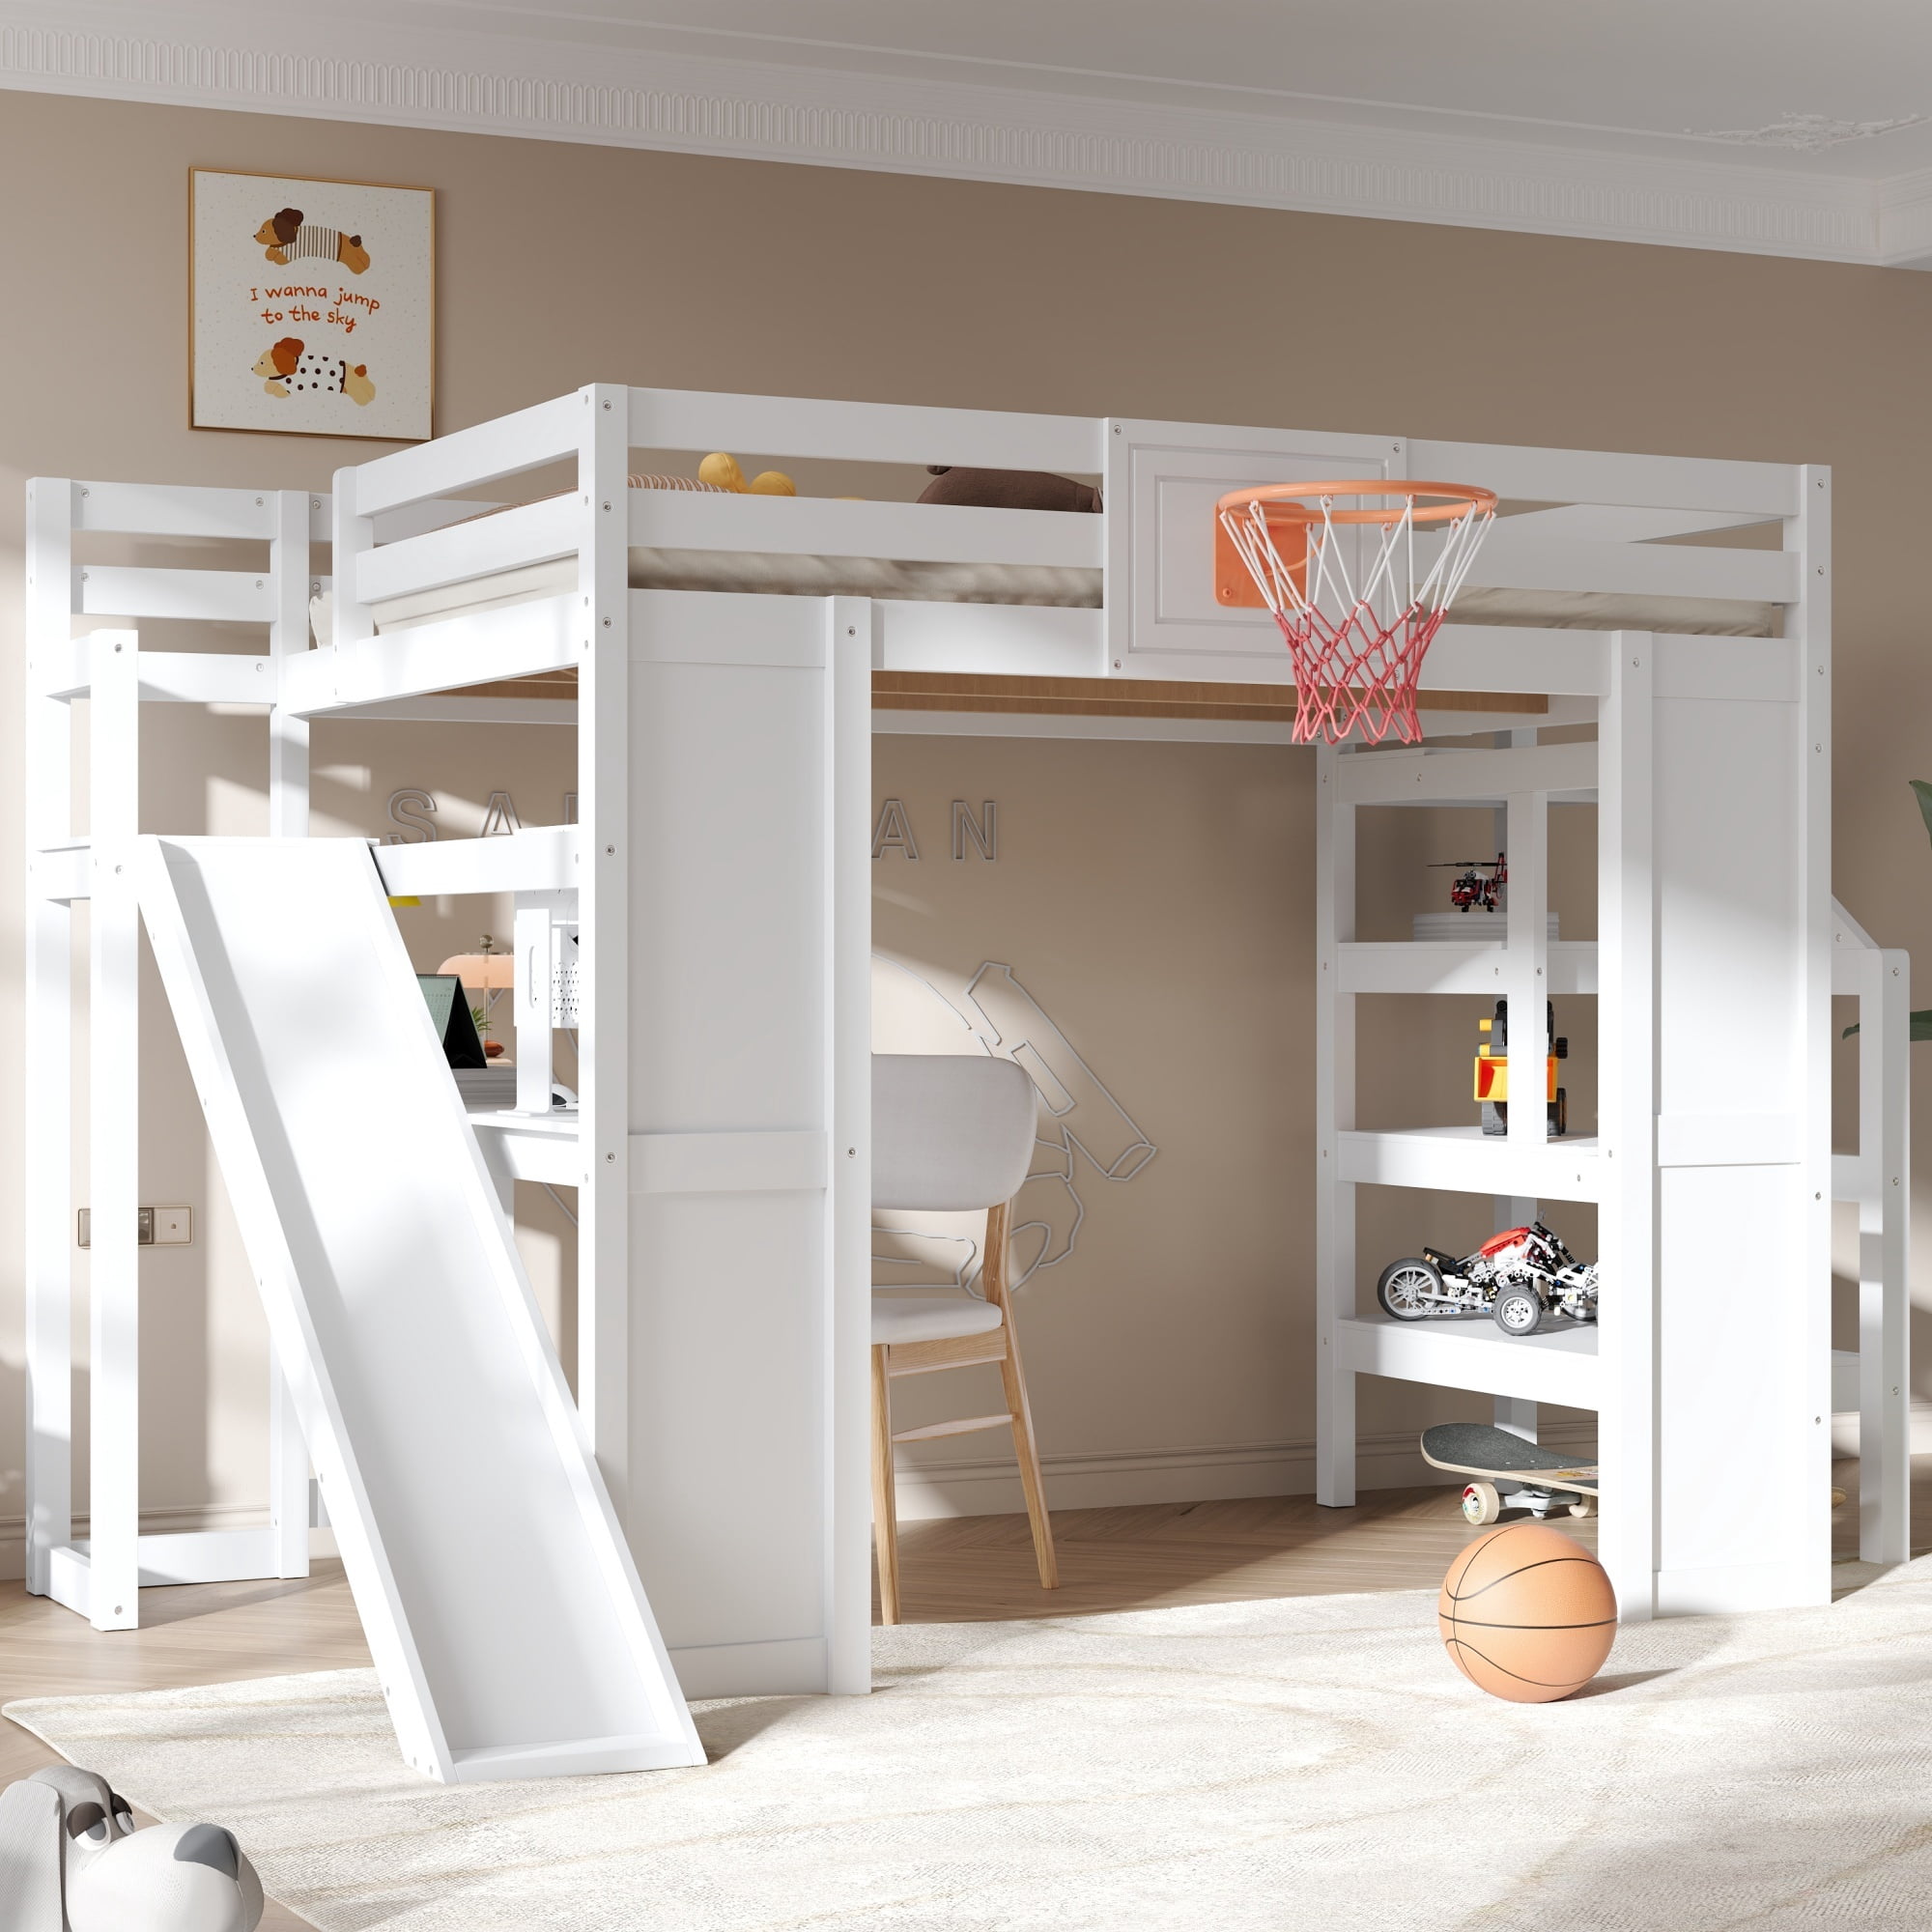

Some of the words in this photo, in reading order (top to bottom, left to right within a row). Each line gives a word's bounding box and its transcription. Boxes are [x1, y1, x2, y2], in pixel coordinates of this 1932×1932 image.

[250, 288, 258, 301] I
[265, 286, 327, 298] wanna
[333, 287, 381, 315] jump
[261, 309, 283, 325] to
[288, 304, 321, 322] the
[327, 307, 356, 333] sky
